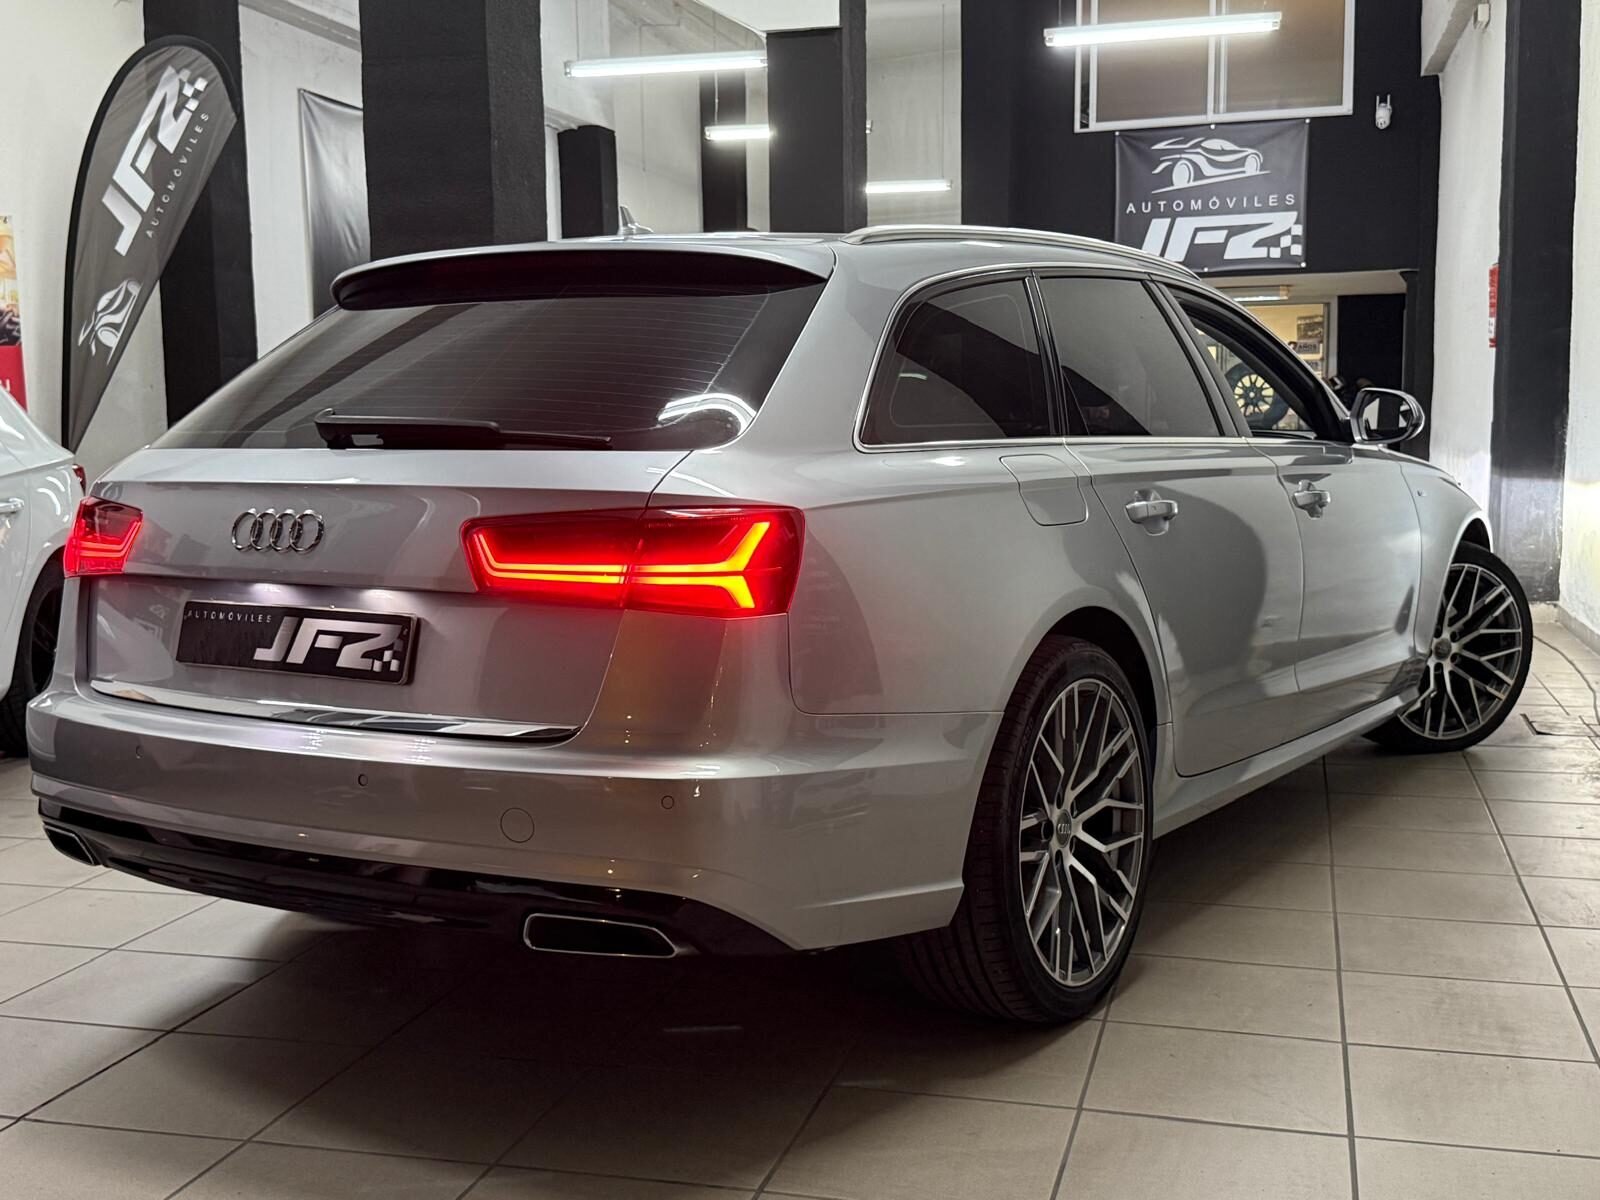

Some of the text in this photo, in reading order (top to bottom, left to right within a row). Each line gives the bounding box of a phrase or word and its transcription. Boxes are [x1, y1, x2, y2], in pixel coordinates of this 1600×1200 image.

[102, 65, 194, 257] JFZ
[1126, 194, 1295, 214] AUTOMÓVILES
[253, 616, 402, 670] JFZ
